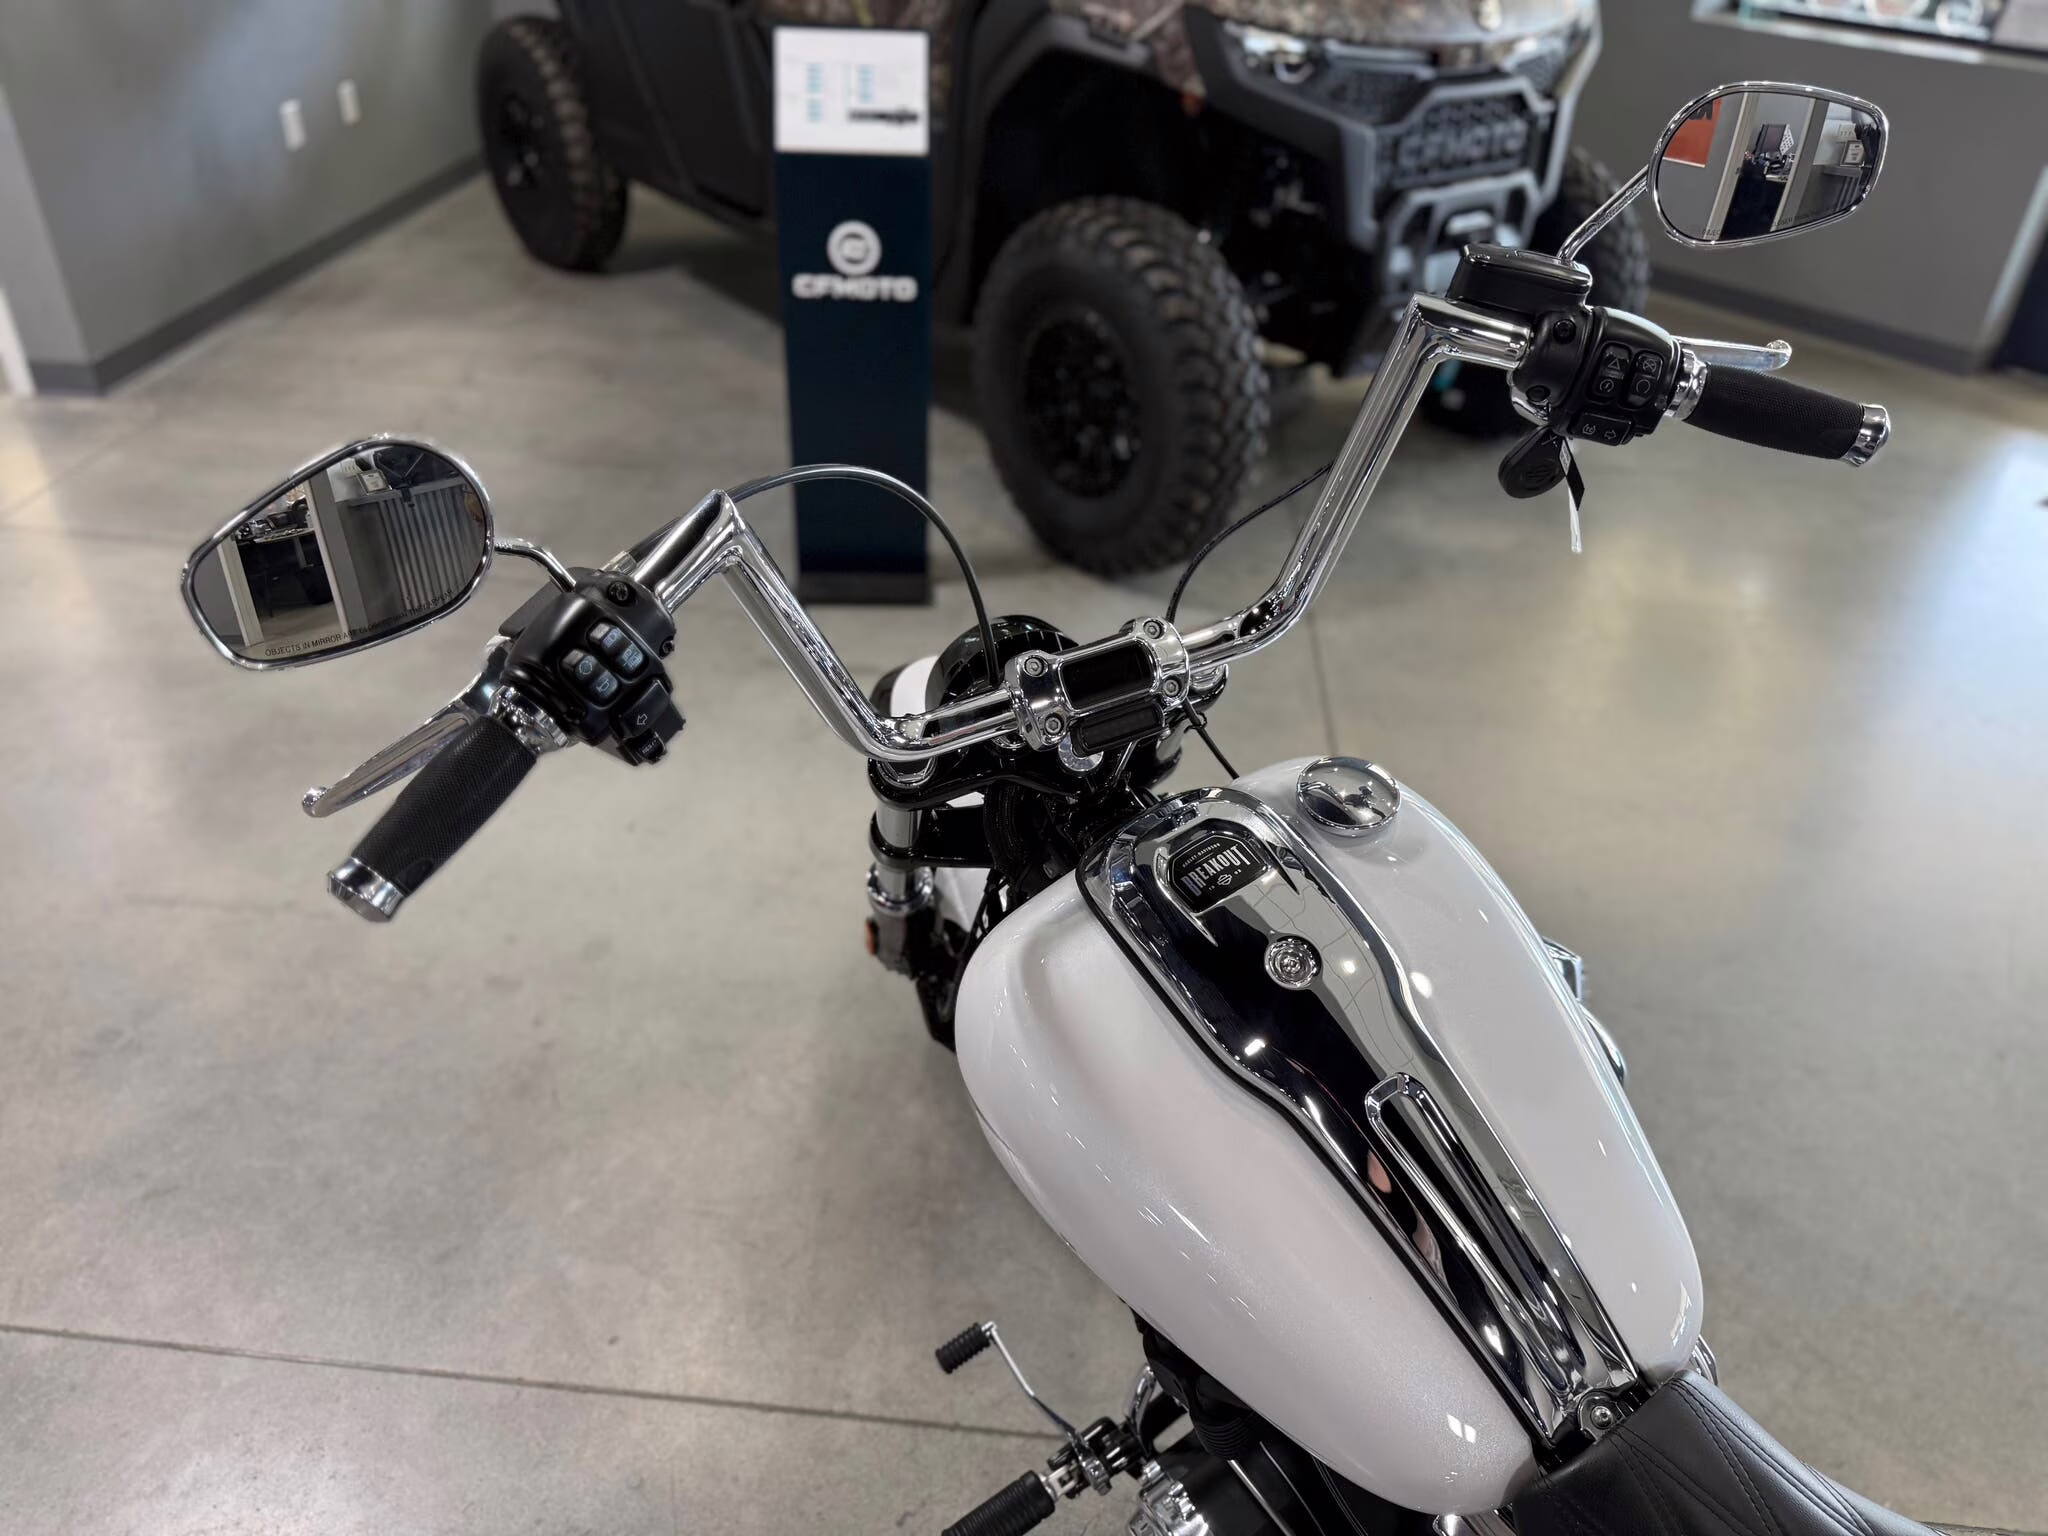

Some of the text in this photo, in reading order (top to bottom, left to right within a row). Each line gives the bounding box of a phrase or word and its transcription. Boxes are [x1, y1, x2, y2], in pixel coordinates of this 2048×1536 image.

[792, 273, 918, 302] CFMOTO
[264, 643, 301, 657] OBJECTS
[302, 641, 311, 650] IN
[311, 633, 342, 648] MIRROR
[1180, 845, 1251, 897] BREAKOUT
